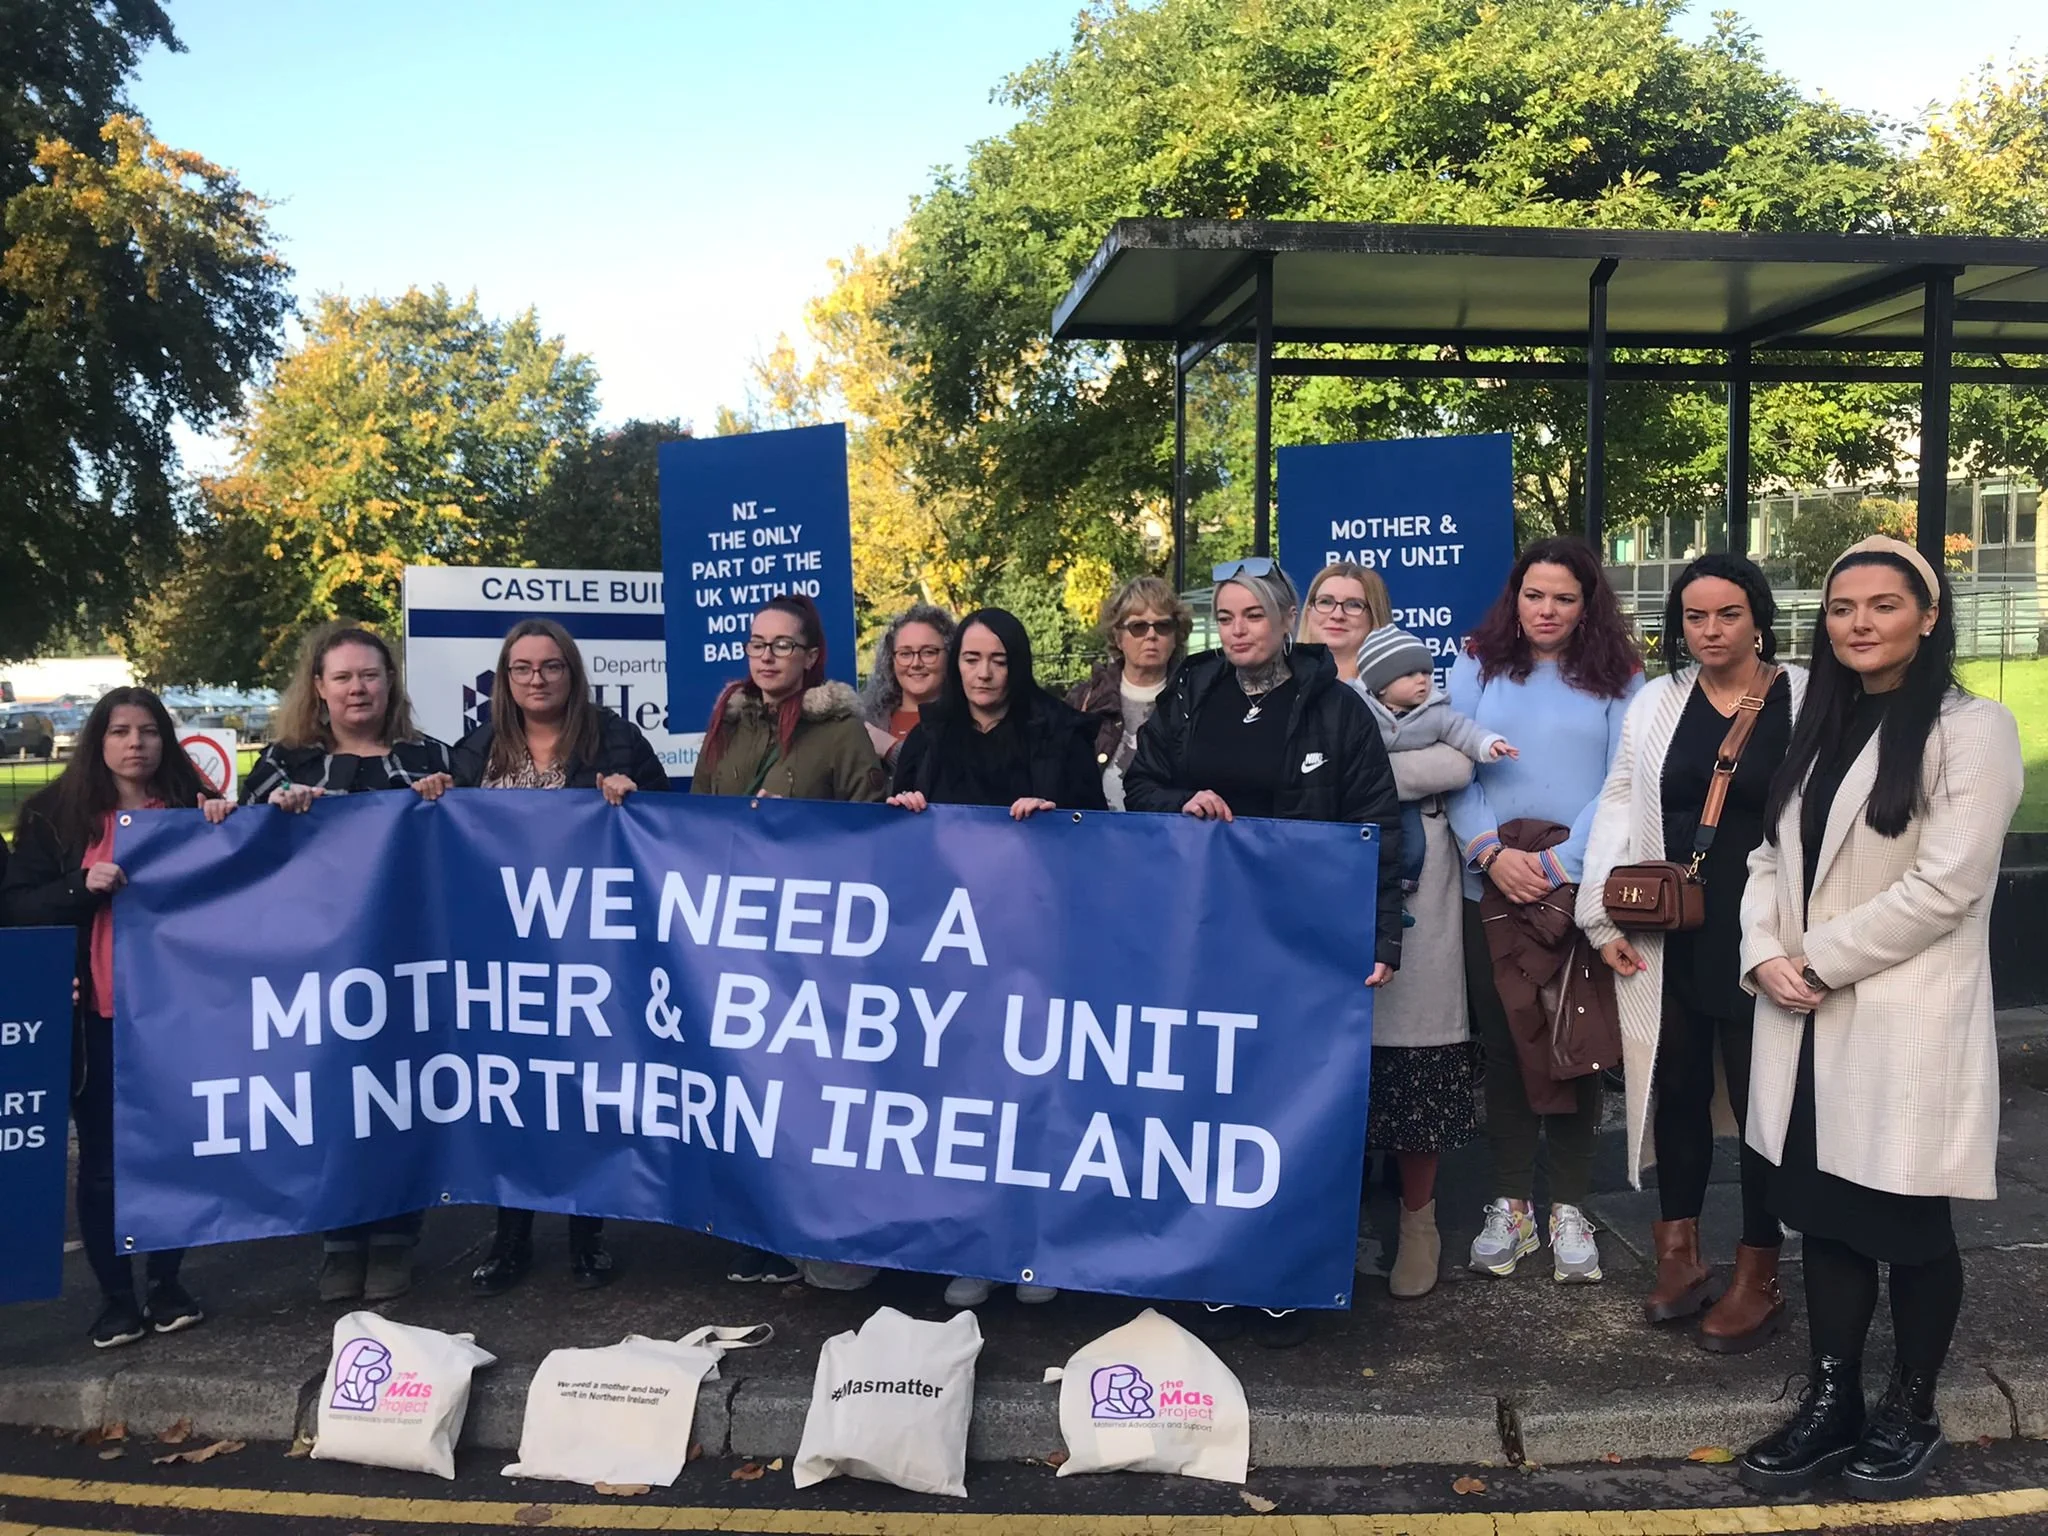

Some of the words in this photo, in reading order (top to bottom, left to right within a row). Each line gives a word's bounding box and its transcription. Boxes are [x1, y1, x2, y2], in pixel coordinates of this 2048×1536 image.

[732, 501, 758, 521] NI
[708, 530, 747, 551] THE
[752, 525, 802, 547] ONLY
[1331, 515, 1431, 541] MOTHER
[1439, 514, 1458, 534] &
[692, 558, 745, 581] PART
[751, 555, 777, 575] OF
[783, 551, 822, 572] THE
[1325, 548, 1392, 569] BABY
[1401, 544, 1464, 567] UNIT
[481, 578, 600, 602] CASTLE
[695, 588, 723, 608] UK
[730, 582, 787, 604] WITH
[792, 580, 820, 599] NO
[708, 613, 755, 634] MOT
[1392, 606, 1452, 628] PING
[704, 642, 745, 663] BAB
[657, 748, 700, 764] ealth
[500, 866, 637, 940] WE
[657, 871, 890, 957] NEED
[921, 887, 989, 966] A
[1, 1020, 43, 1046] BY
[251, 959, 613, 1050] MOTHER
[645, 966, 685, 1043] &
[710, 972, 968, 1068] BABY
[1003, 994, 1258, 1094] UNIT
[0, 1090, 47, 1116] RT
[0, 1125, 46, 1152] DS
[191, 1070, 314, 1157] IN
[352, 1053, 784, 1159] NORTHERN
[811, 1084, 1281, 1209] IRELAND
[385, 1381, 433, 1398] Mas
[560, 1391, 577, 1399] unit
[579, 1391, 587, 1399] in
[589, 1392, 625, 1403] Northern
[571, 1381, 592, 1389] need
[600, 1383, 630, 1391] mother
[631, 1385, 648, 1393] and
[648, 1386, 670, 1397] baby
[831, 1378, 944, 1402] #Masmatter
[1159, 1380, 1184, 1391] The
[378, 1399, 429, 1416] Project
[1160, 1390, 1214, 1407] Mas
[1159, 1405, 1214, 1421] Project
[1167, 1421, 1182, 1429] and
[1183, 1422, 1213, 1433] Support
